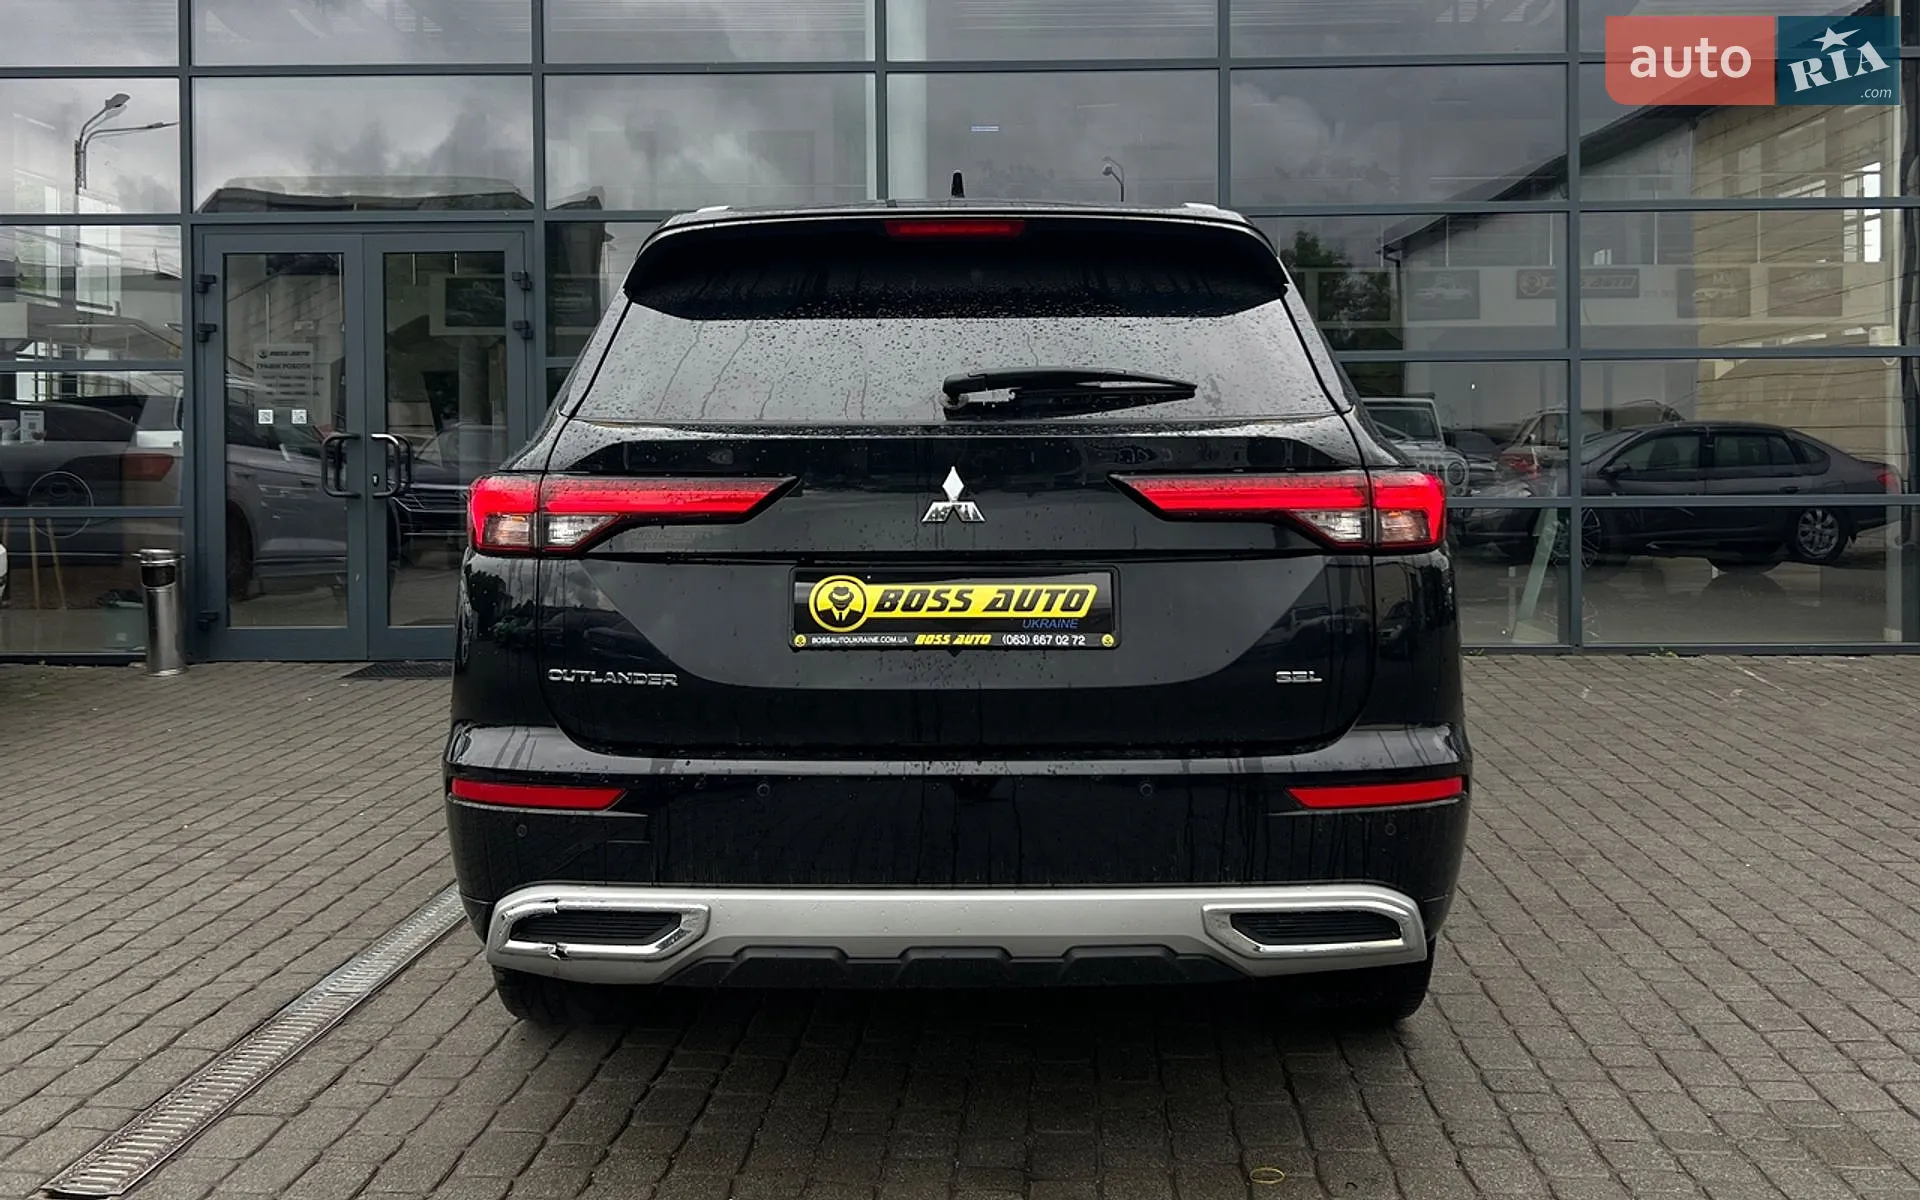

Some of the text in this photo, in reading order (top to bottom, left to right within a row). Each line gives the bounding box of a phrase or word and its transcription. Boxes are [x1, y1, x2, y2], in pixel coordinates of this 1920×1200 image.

[873, 588, 1090, 613] BOSS AUTO
[1022, 618, 1079, 630] UKRAINE
[915, 634, 992, 645] BOSS AUTO
[1002, 634, 1086, 647] (063) 667 02 72
[548, 668, 679, 687] OUTLANDER
[1276, 670, 1323, 683] SEL
